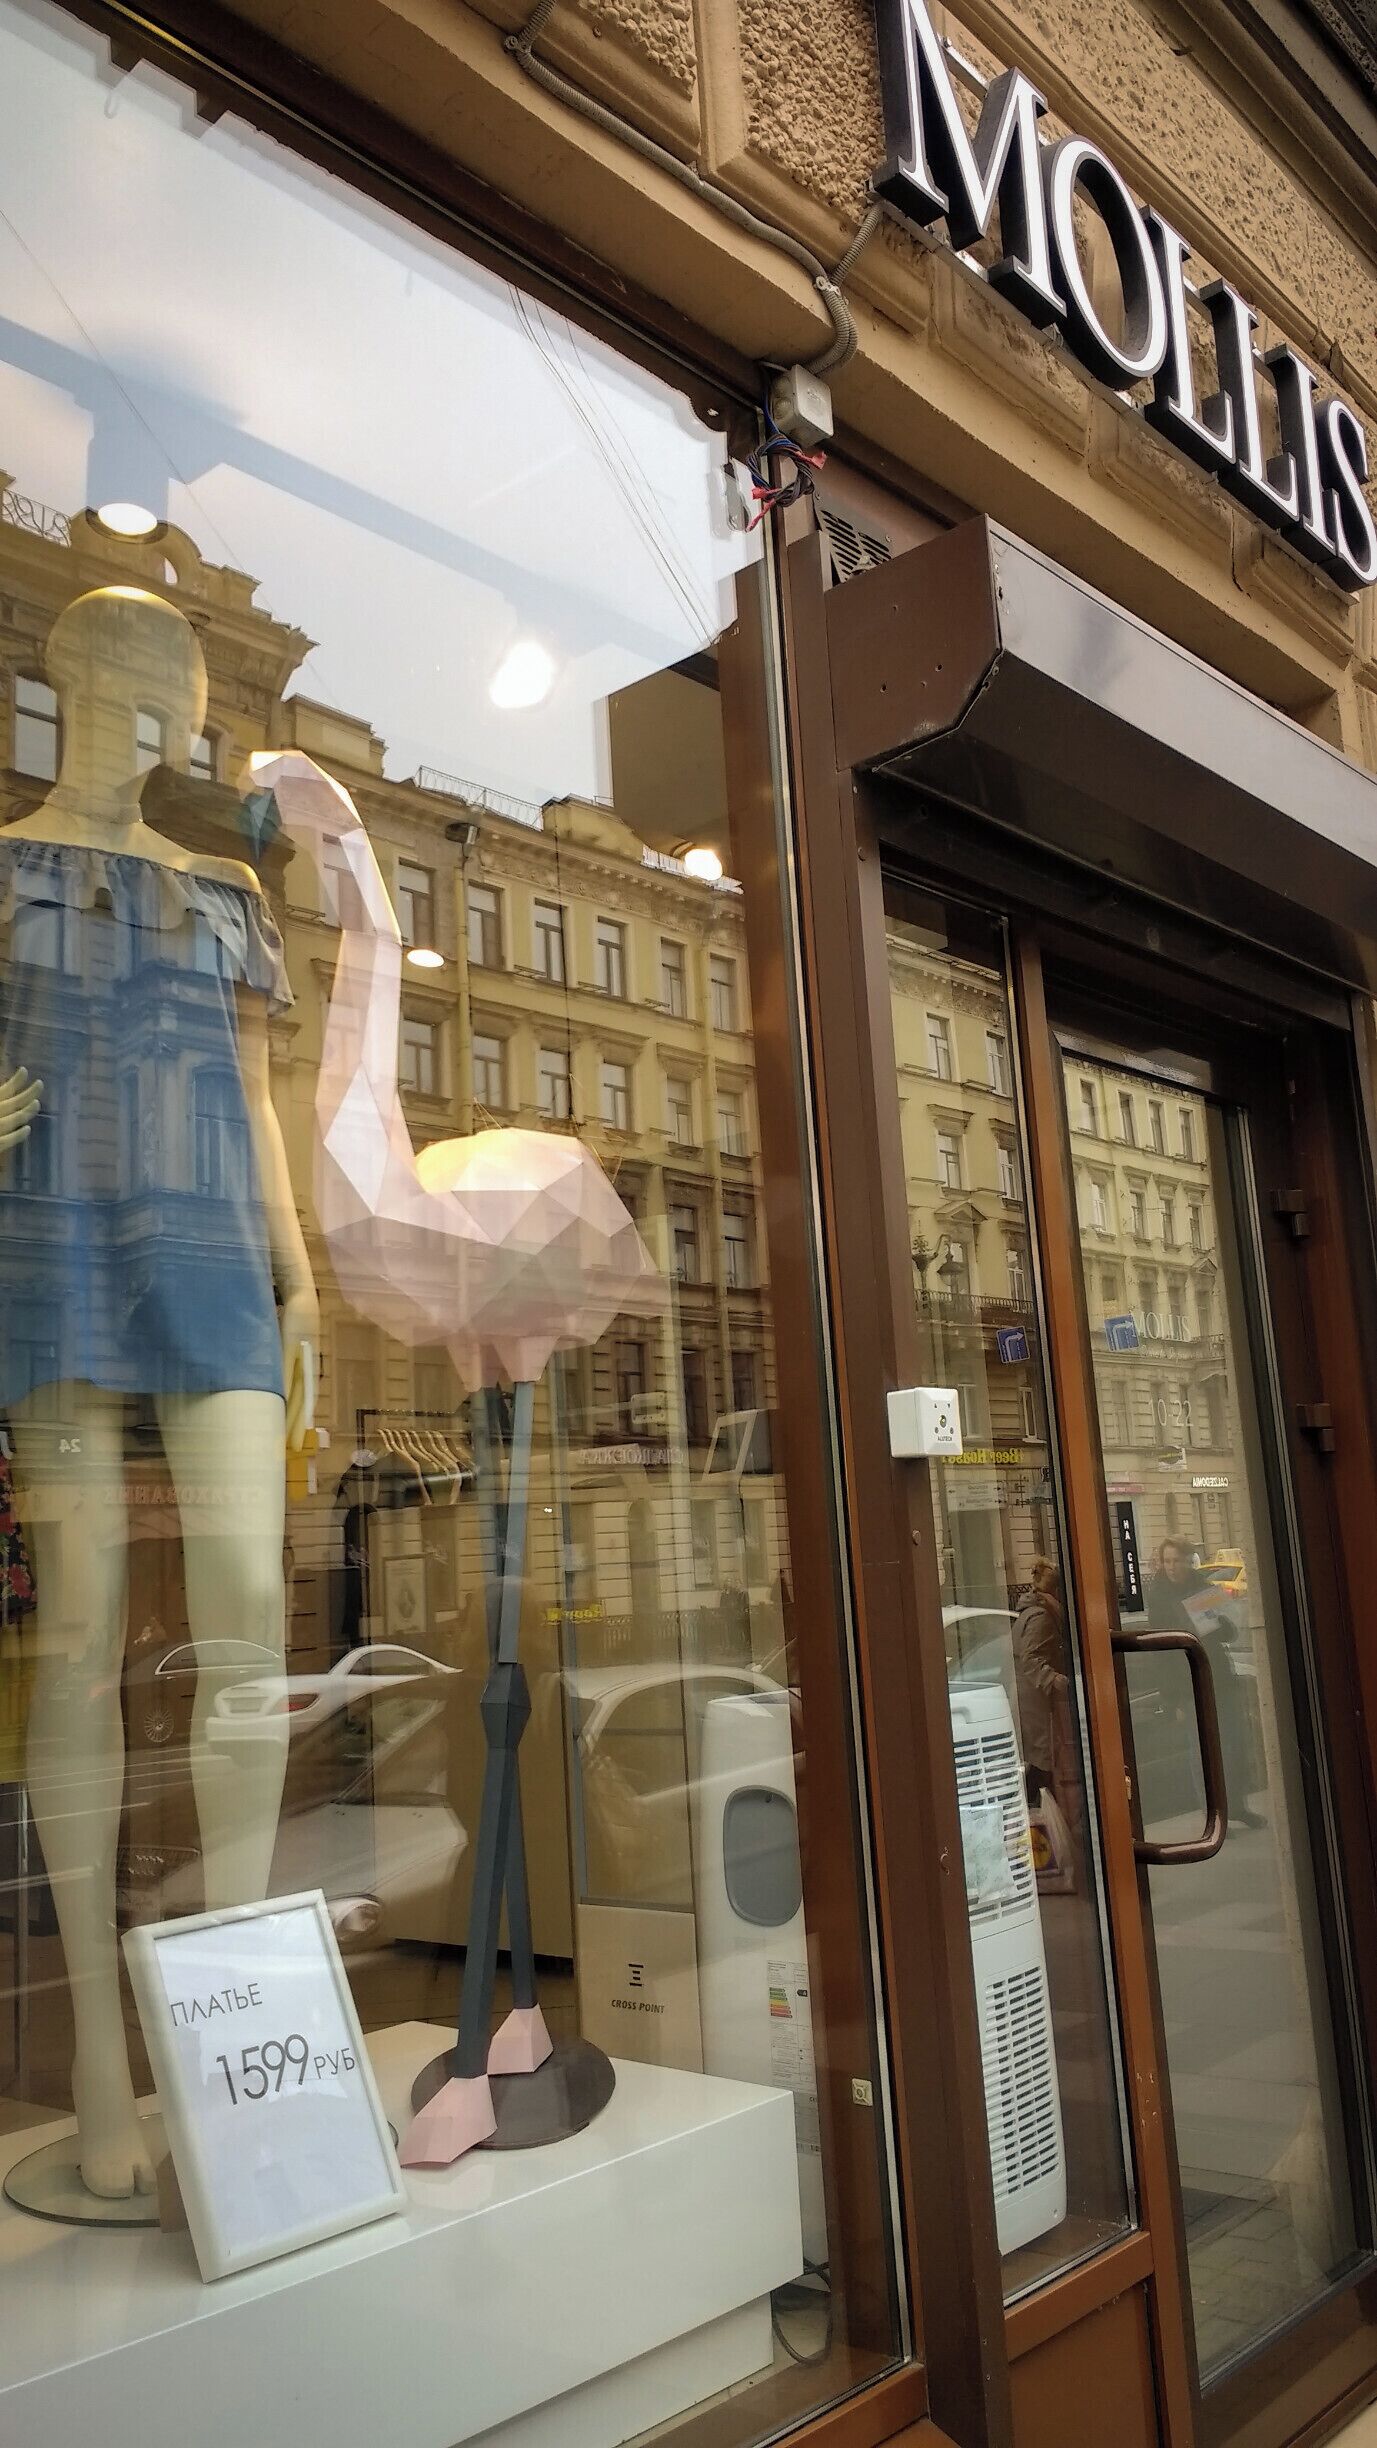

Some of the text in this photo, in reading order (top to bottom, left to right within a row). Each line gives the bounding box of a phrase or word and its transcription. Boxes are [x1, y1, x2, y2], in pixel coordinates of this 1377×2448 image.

[885, 0, 1377, 588] MOLLIS
[1130, 1310, 1193, 1343] MOLLIS
[1148, 1399, 1194, 1427] 10-22
[1123, 1519, 1137, 1595] НА СЕБЯ
[170, 1982, 263, 2027] ПЛАТЬЕ
[611, 1999, 665, 2014] CROSS POINT
[216, 2033, 355, 2105] 1599 РУБ
